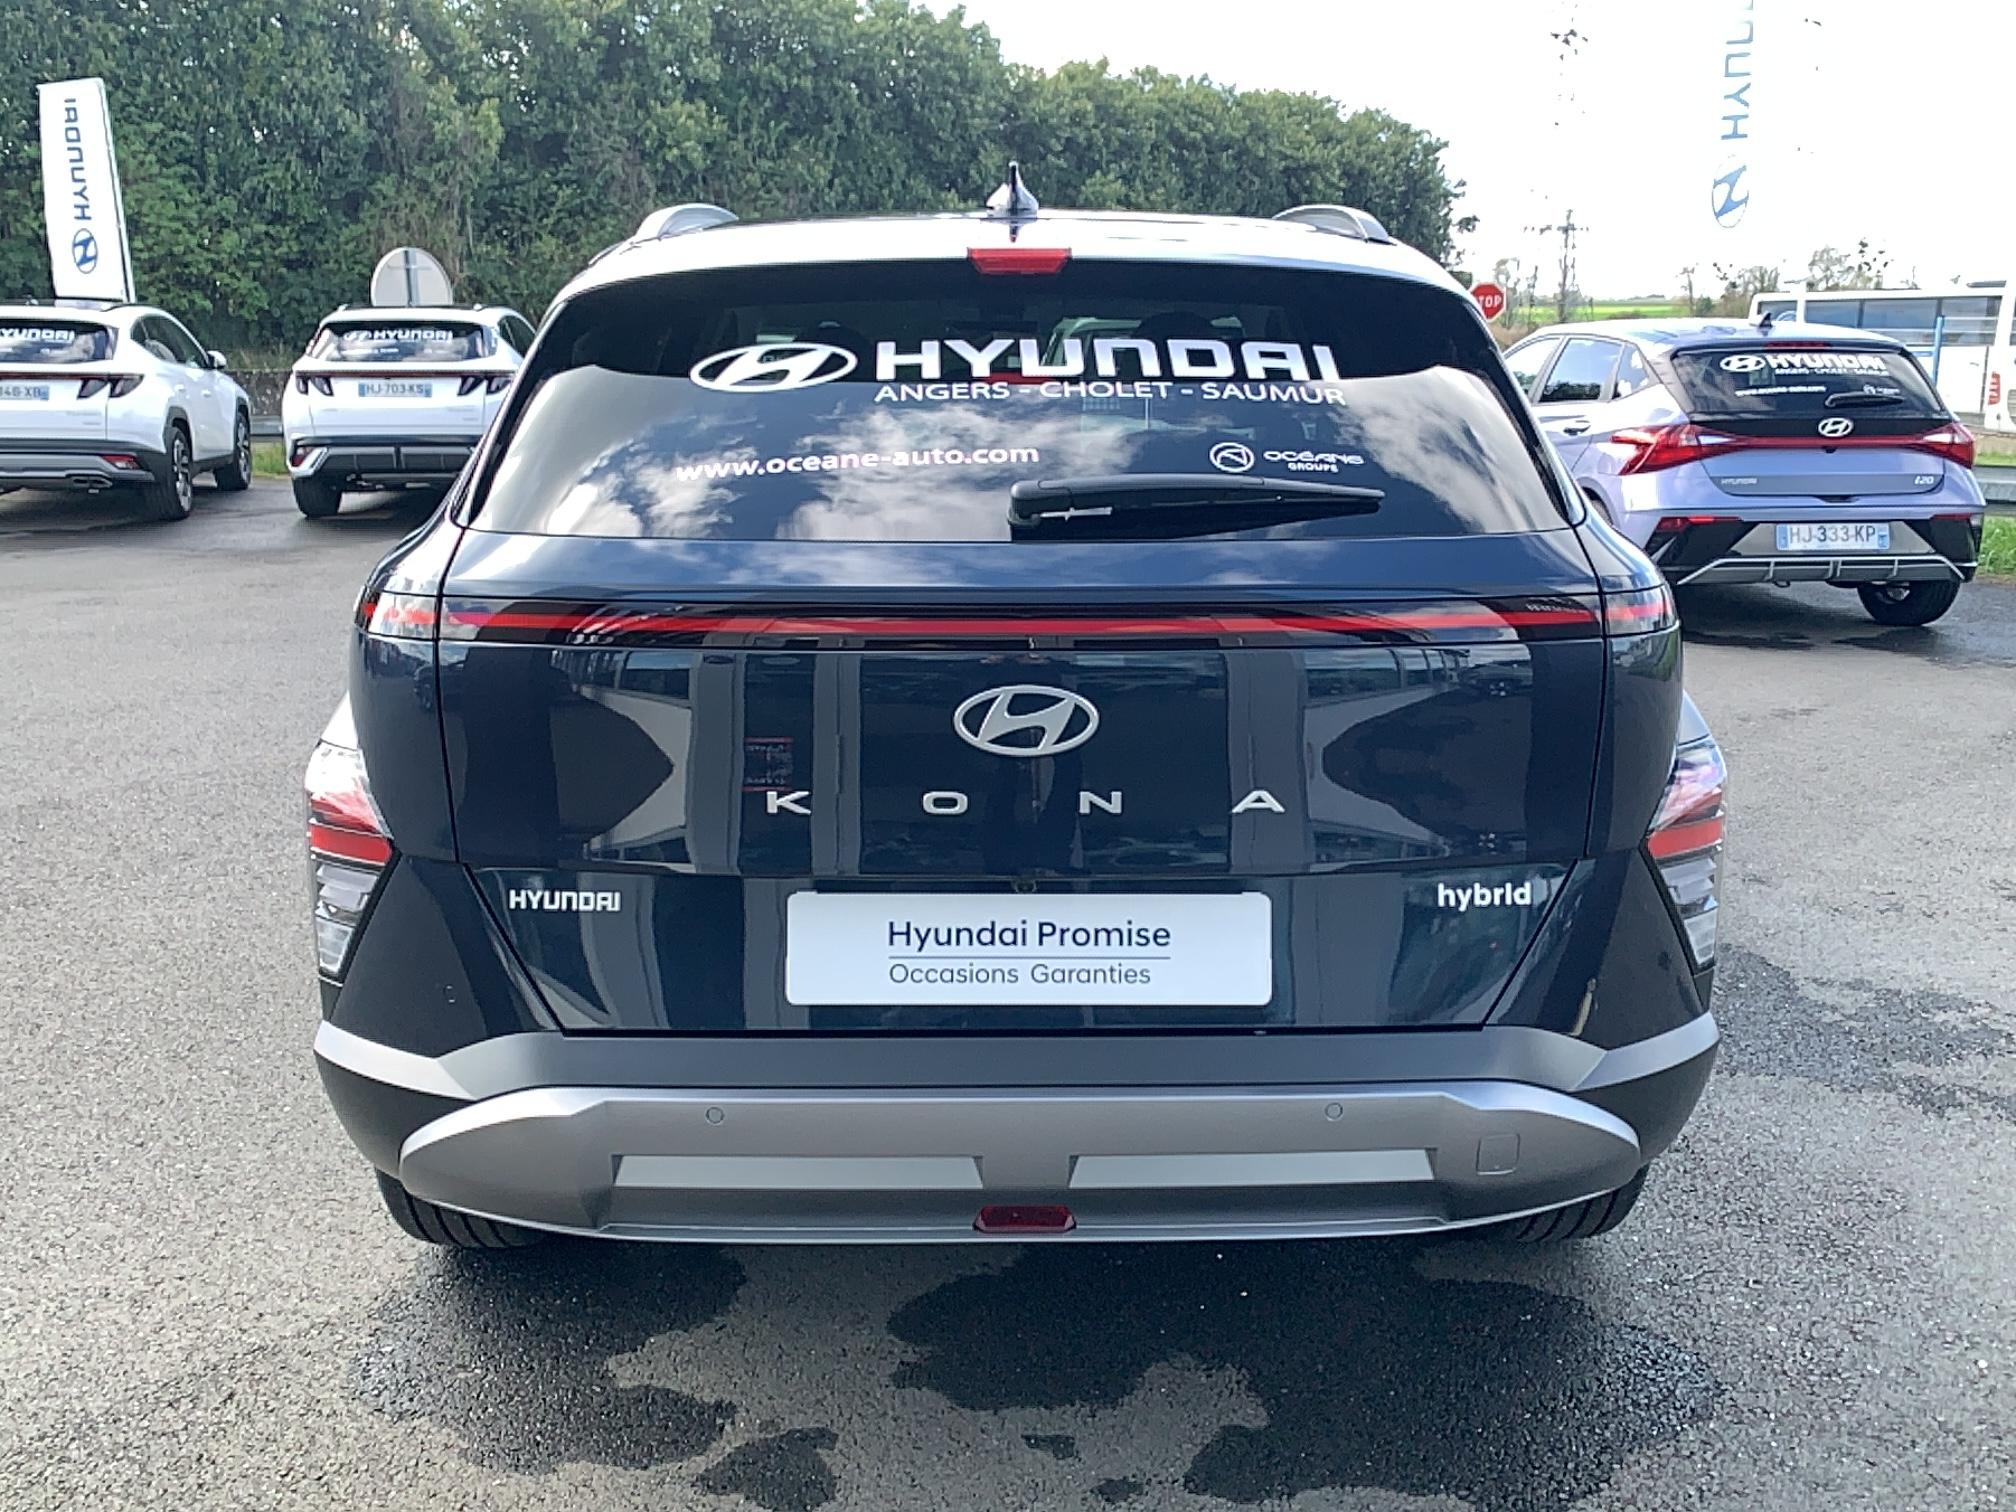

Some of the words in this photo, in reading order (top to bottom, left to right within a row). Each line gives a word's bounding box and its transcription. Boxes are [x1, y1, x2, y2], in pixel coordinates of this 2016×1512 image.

[374, 330, 453, 344] HYUNDAI
[876, 338, 1342, 382] HYUNDAI
[1766, 353, 1887, 370] HYUNDAI
[874, 382, 1010, 402] ANGERS
[1040, 381, 1173, 399] CHOLET
[1203, 382, 1347, 405] SAUMUR
[676, 447, 1039, 482] www.oceane-auto.com
[509, 889, 621, 912] HYUNDAI
[1438, 882, 1532, 912] hybrid
[888, 920, 1028, 952] Hyundai
[1038, 920, 1171, 947] Promise
[889, 962, 1019, 984] Occasions
[1031, 962, 1151, 984] Garanties
